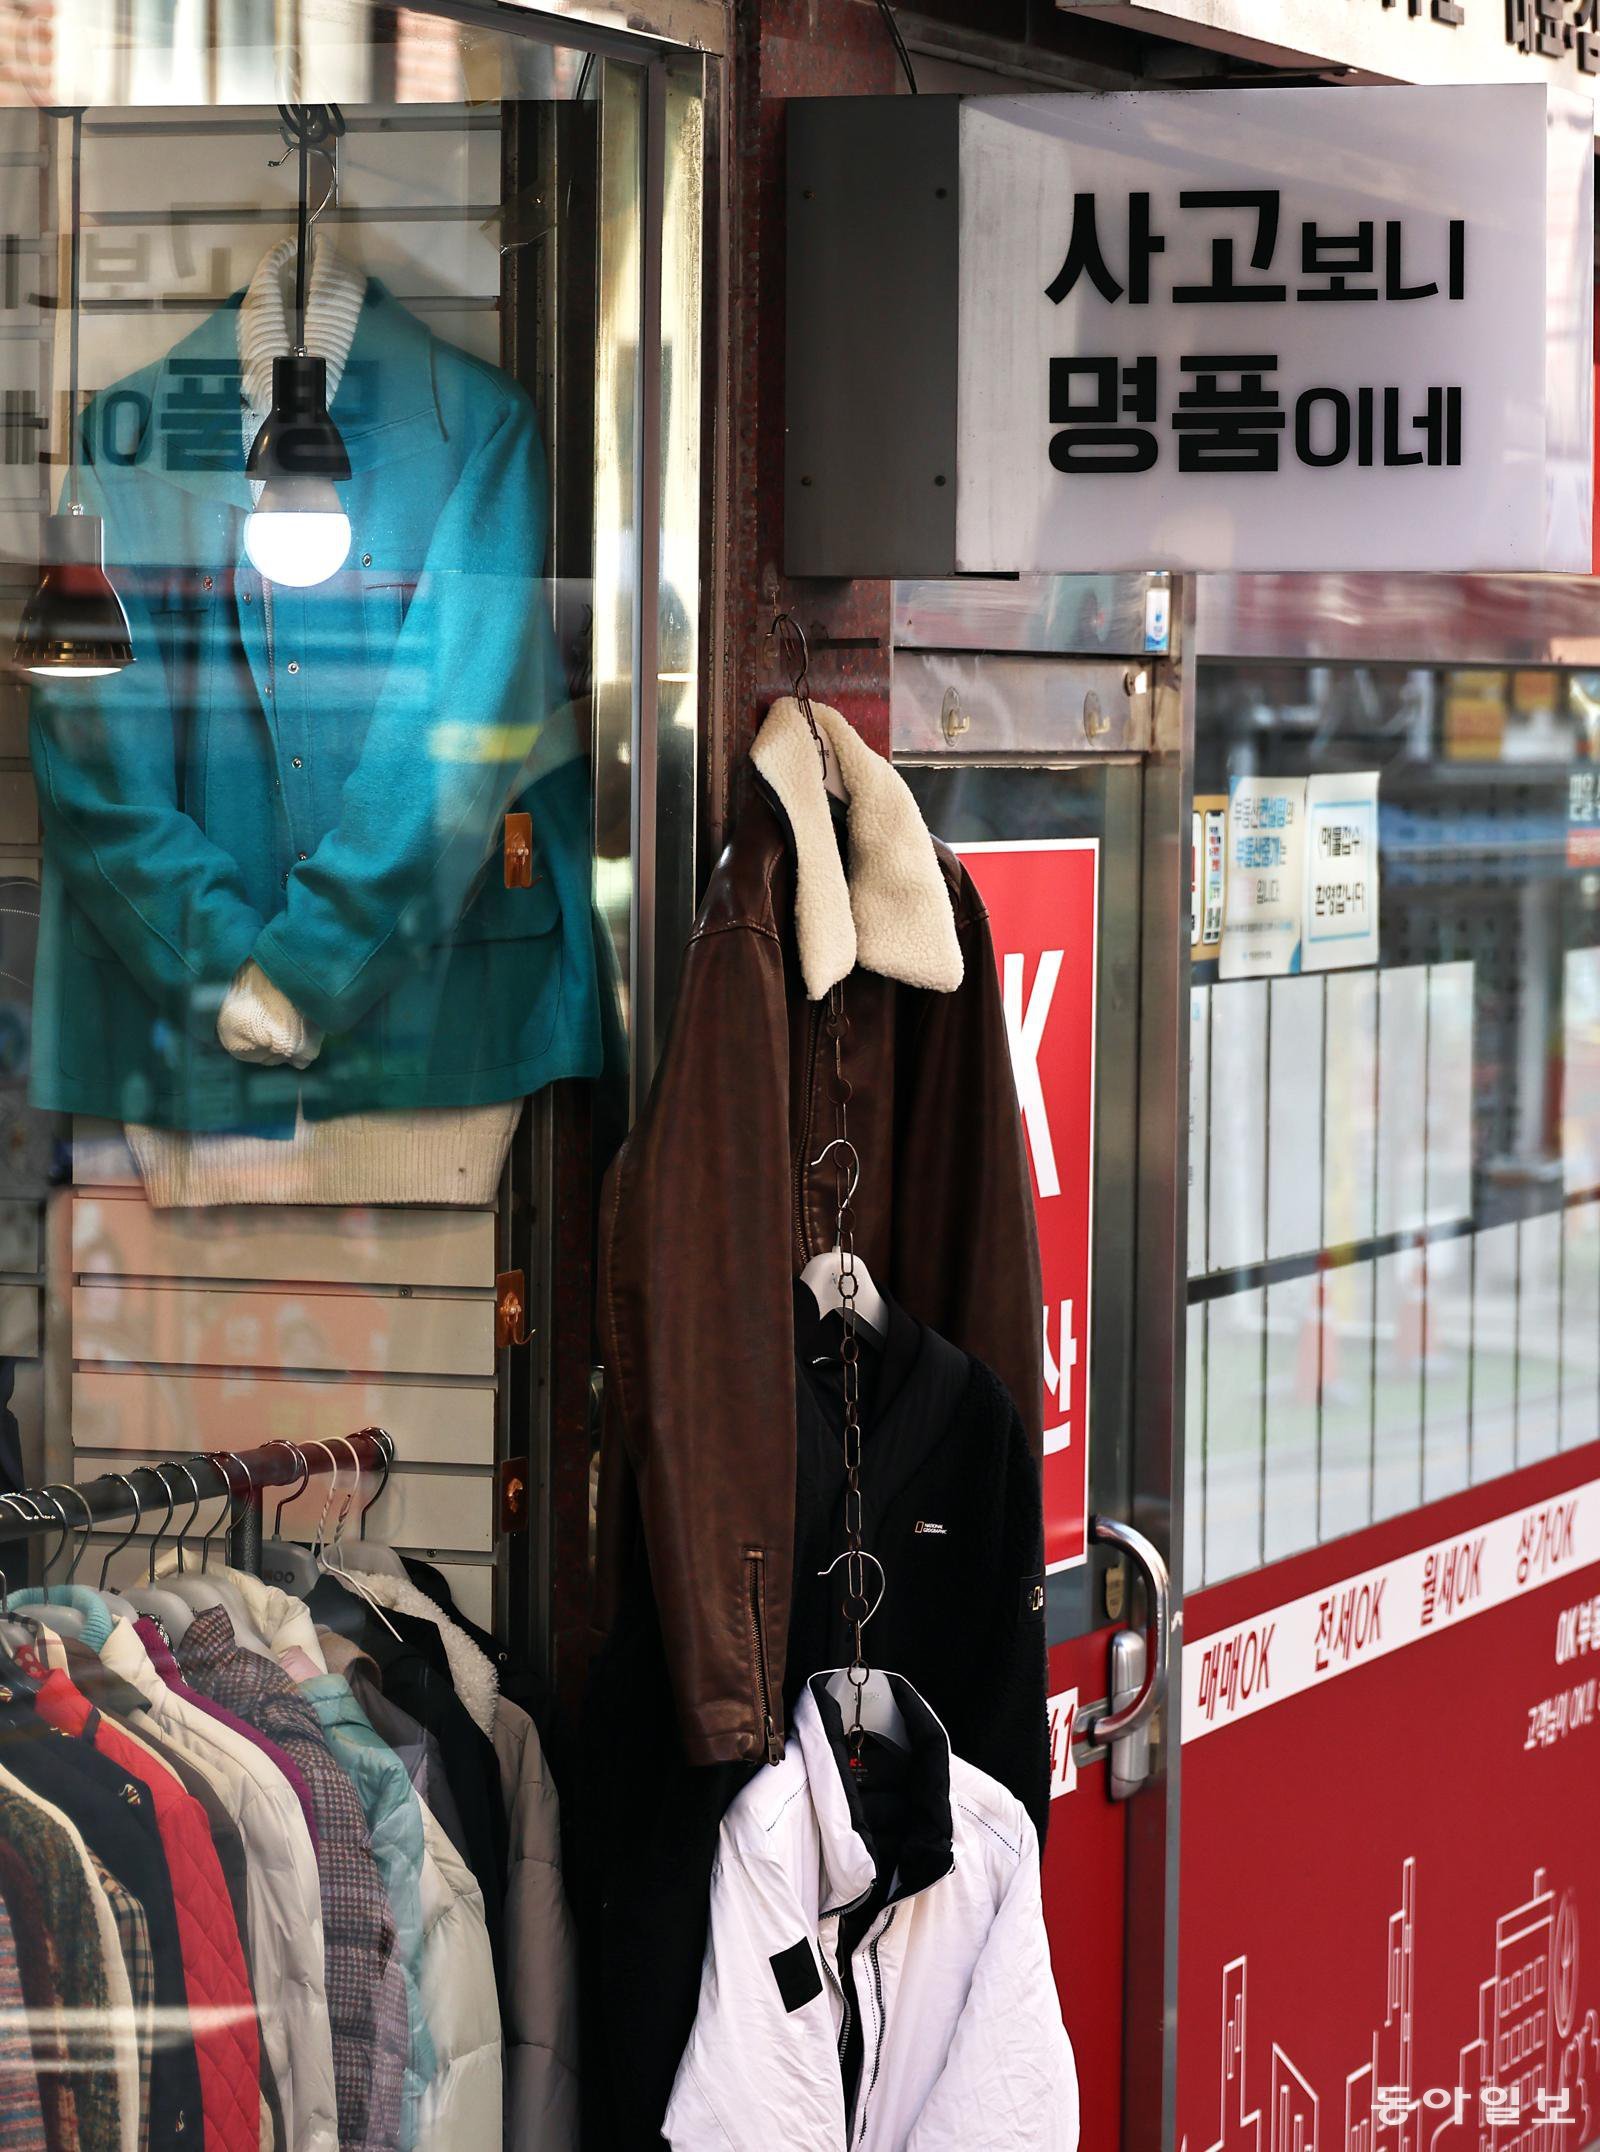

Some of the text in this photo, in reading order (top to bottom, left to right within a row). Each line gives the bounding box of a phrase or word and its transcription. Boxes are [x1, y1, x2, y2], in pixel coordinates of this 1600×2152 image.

[1044, 190, 1464, 305] 사고보니
[1048, 355, 1462, 473] 명품이네
[1314, 881, 1365, 916] 환영합니다
[1321, 825, 1361, 857] 매물접수
[1198, 1500, 1579, 1721] 매매OK 전세OK 월세OK 상가OK
